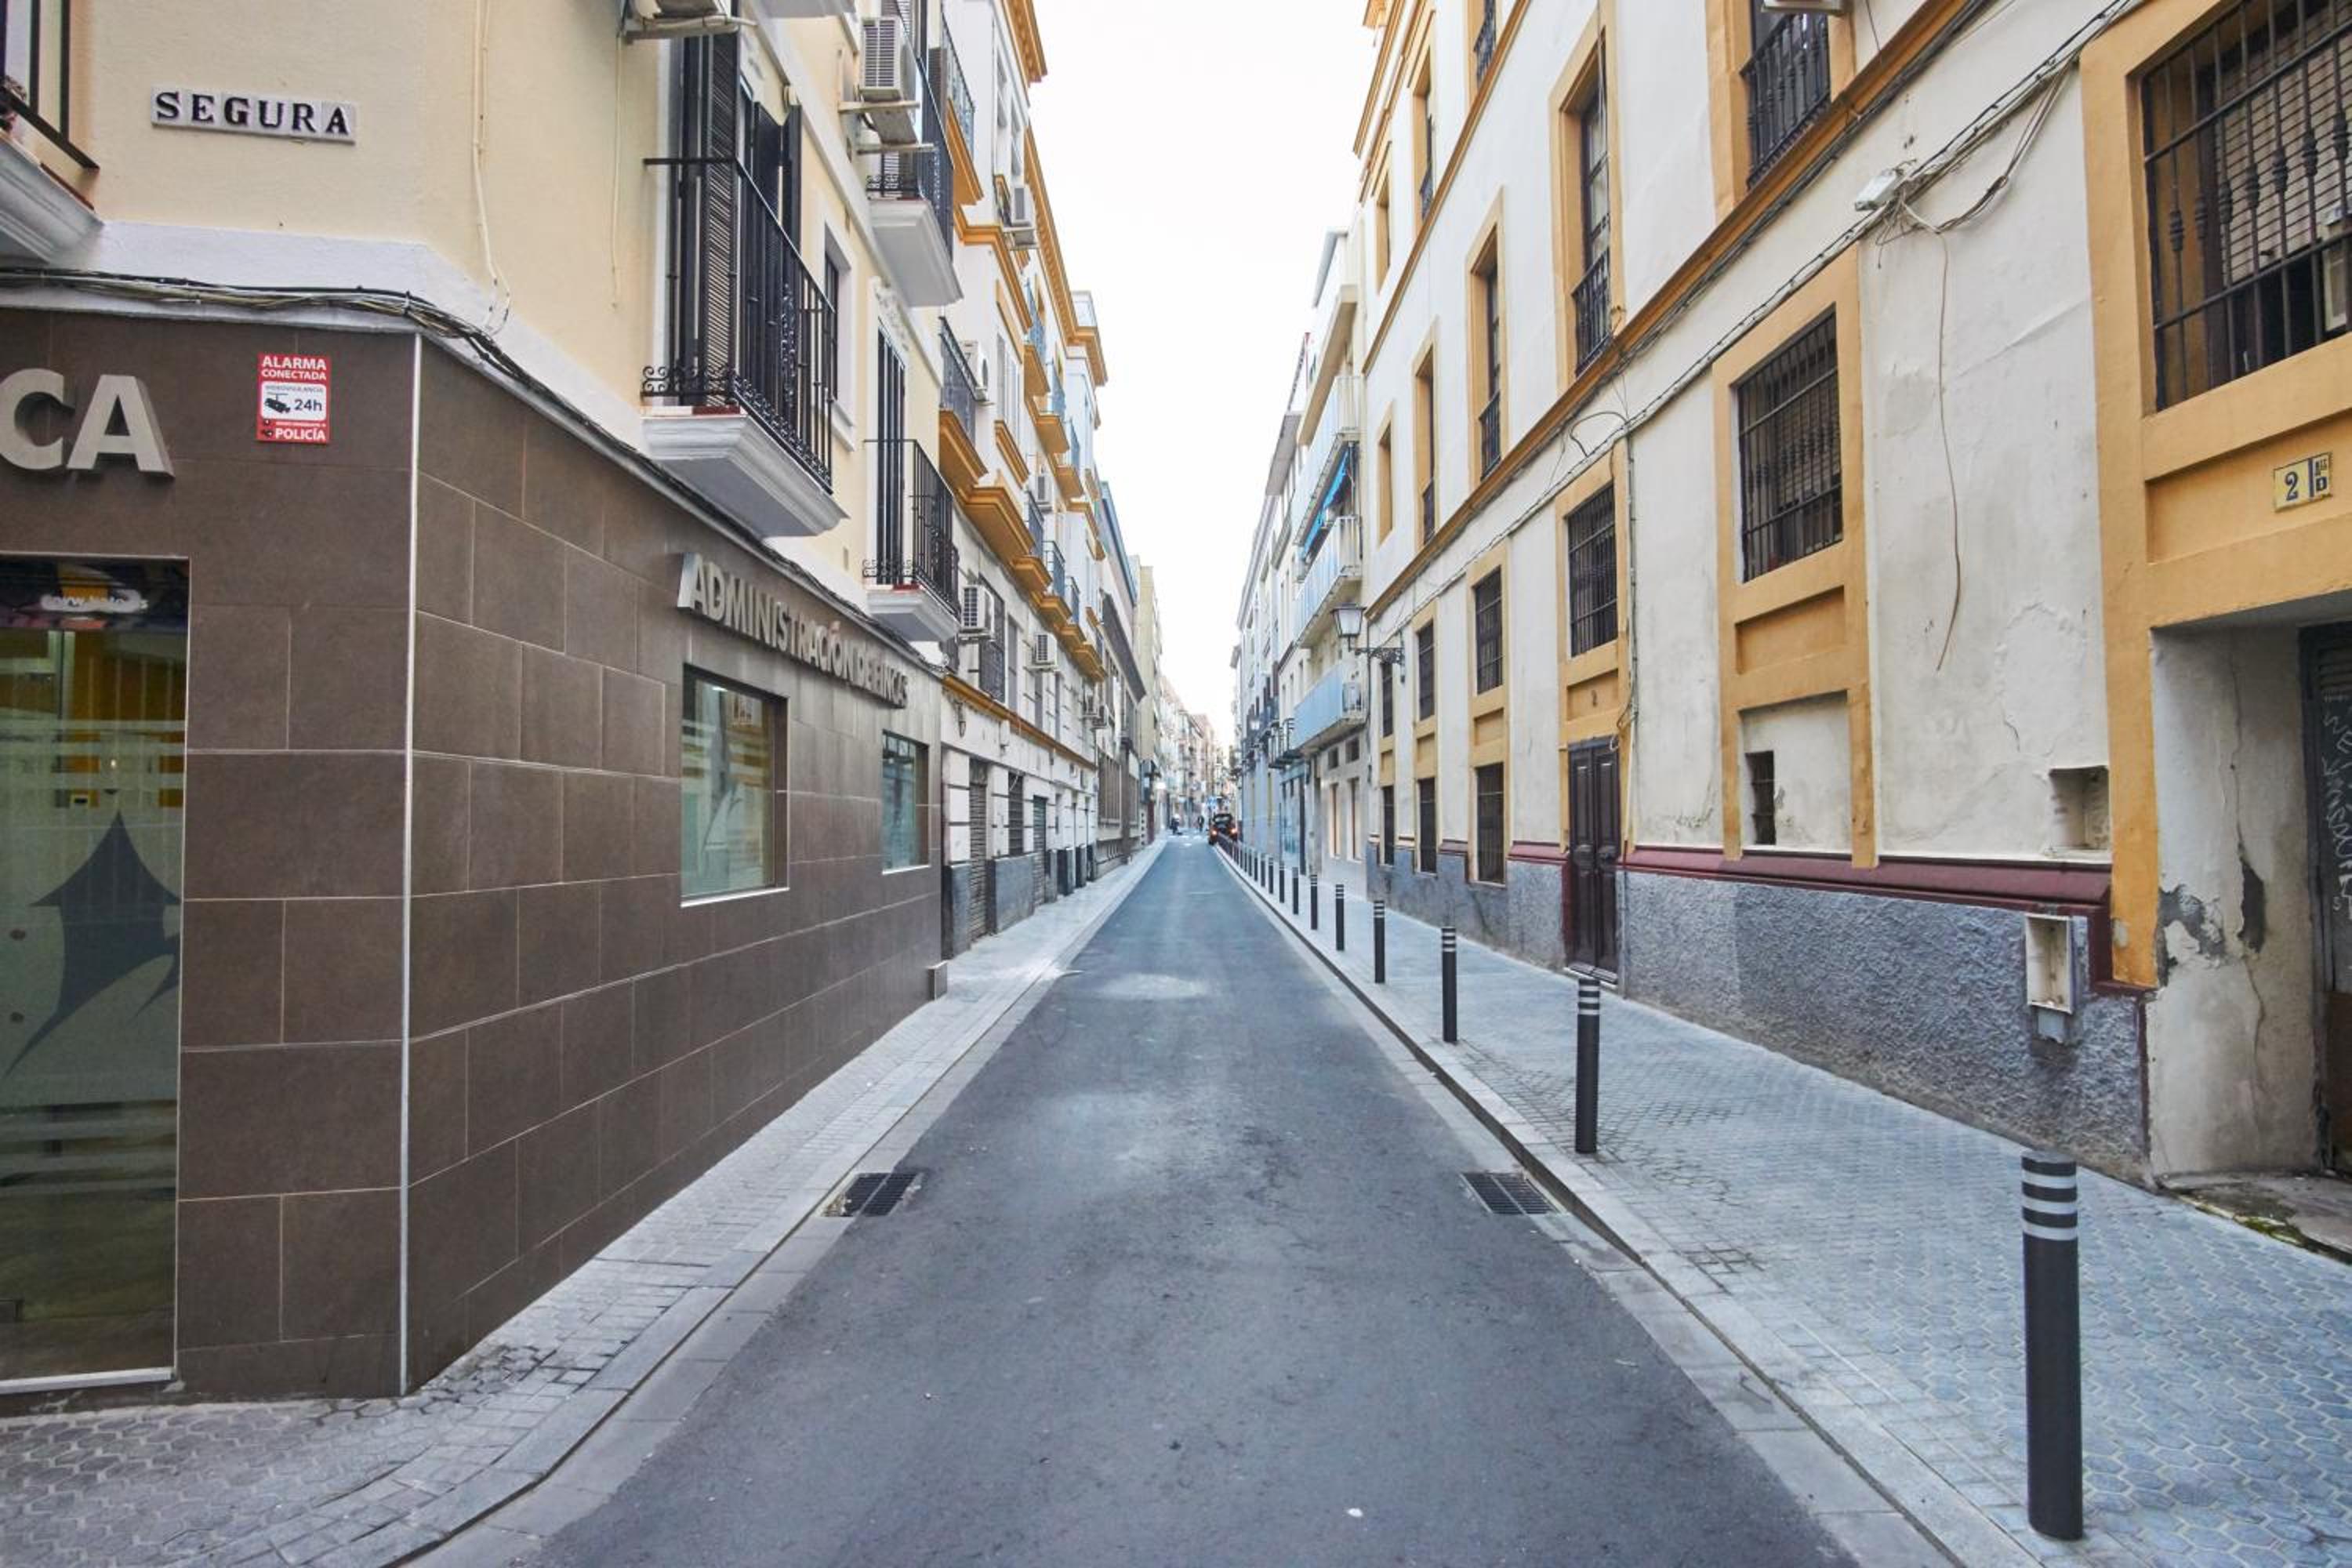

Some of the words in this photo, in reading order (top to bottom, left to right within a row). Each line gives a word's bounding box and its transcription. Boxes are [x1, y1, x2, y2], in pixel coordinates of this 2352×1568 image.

[155, 91, 349, 135] SEGURA
[261, 368, 327, 380] CONECTADA
[263, 355, 327, 371] ALARMA
[294, 398, 323, 412] 24h
[0, 368, 168, 473] CA
[275, 427, 327, 441] POLICÍA
[2285, 471, 2299, 501] 2
[681, 552, 854, 683] ADMINISTRACIÓN
[857, 649, 873, 691] DE
[875, 661, 908, 707] FINCAS
